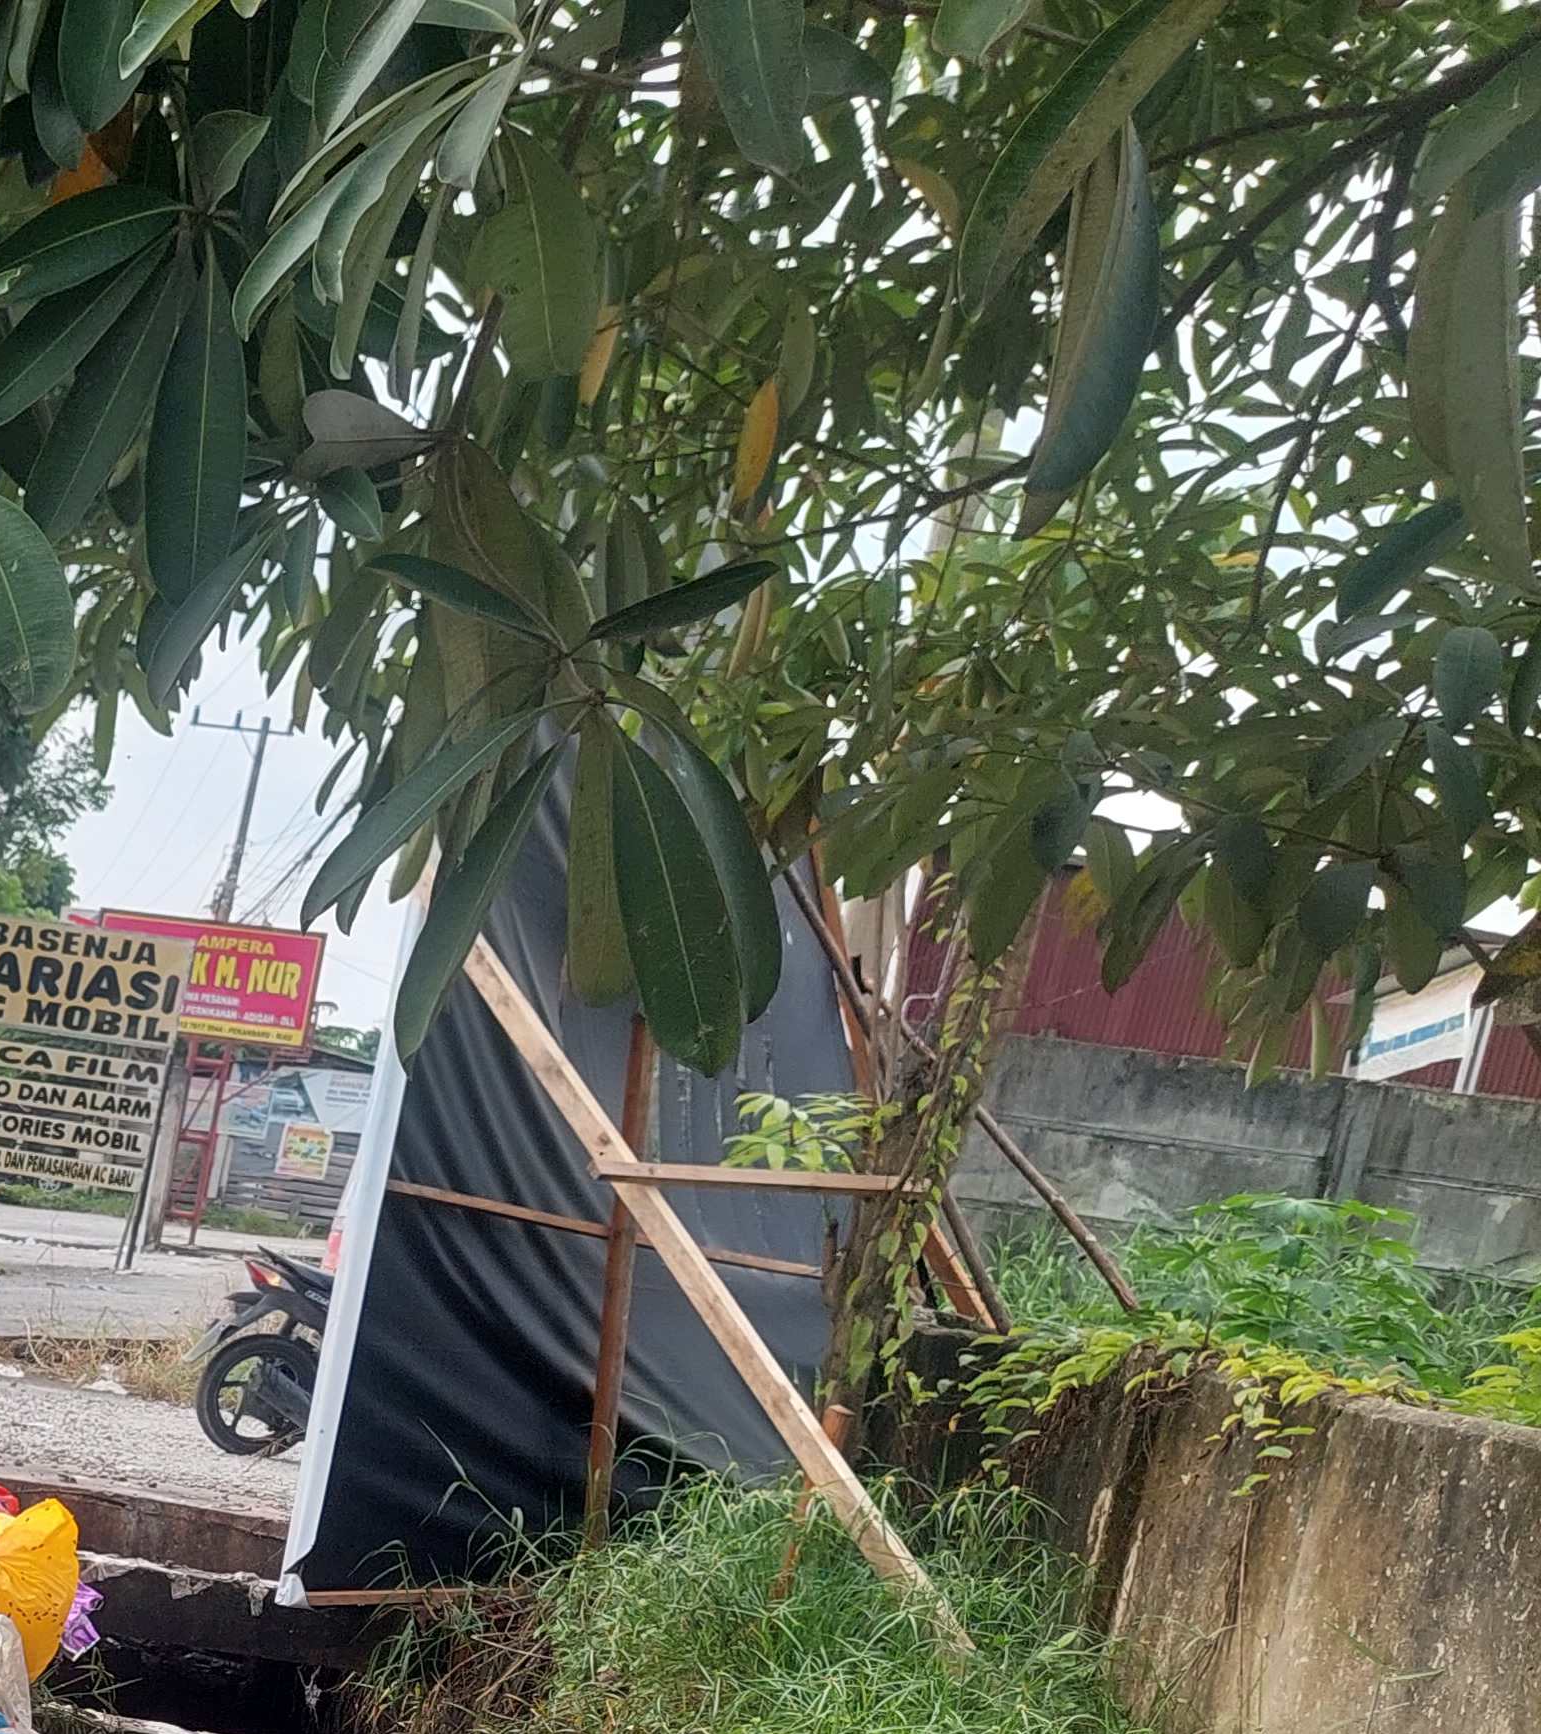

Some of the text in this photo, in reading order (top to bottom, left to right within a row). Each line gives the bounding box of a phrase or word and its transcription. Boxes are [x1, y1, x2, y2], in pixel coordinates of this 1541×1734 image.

[197, 935, 275, 956] AMPERA
[215, 955, 240, 990] M.
[246, 958, 301, 1001] NUR
[23, 998, 169, 1043] MOBIL
[65, 1055, 159, 1084] FILM
[17, 1083, 67, 1106] DAN
[72, 1092, 151, 1119] ALARM
[71, 1126, 142, 1153] MOBIL
[4, 1153, 24, 1170] DAN
[26, 1156, 92, 1182] PEMASANGAN
[93, 1168, 106, 1184] AC
[108, 1170, 135, 1188] BARU
